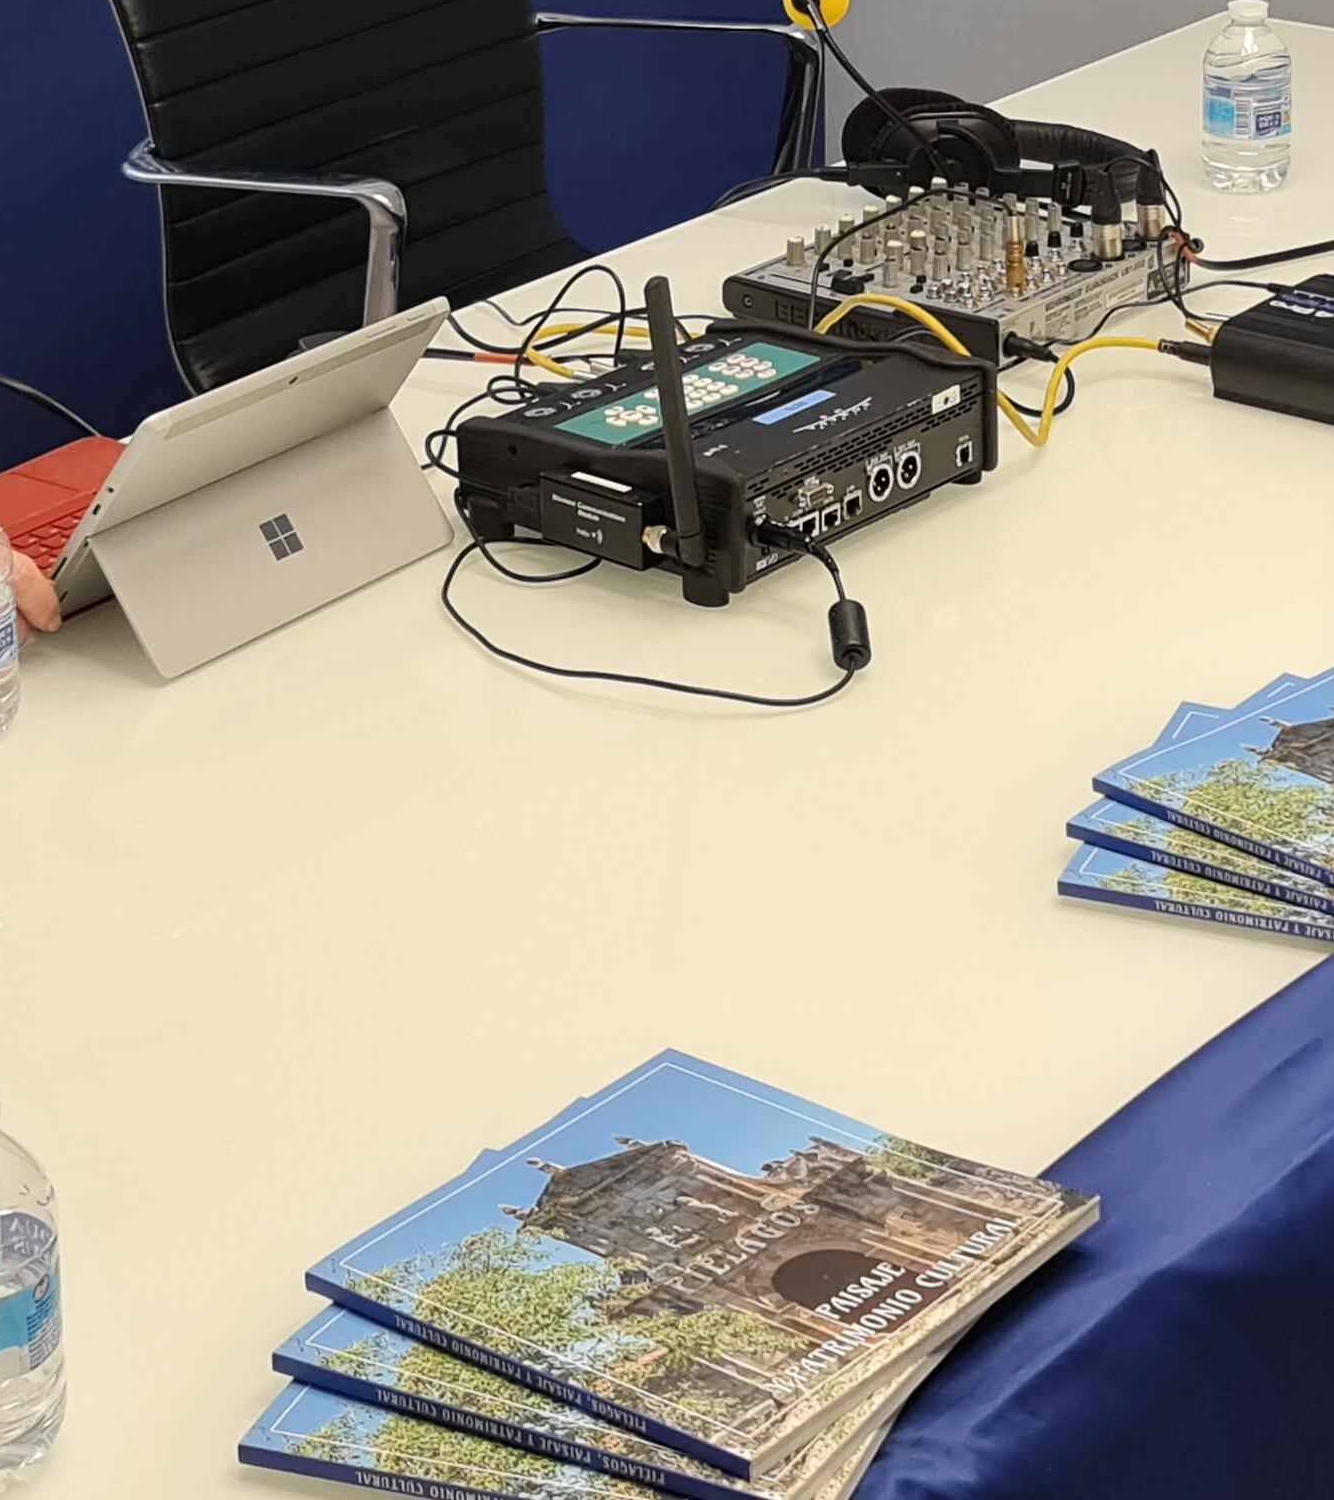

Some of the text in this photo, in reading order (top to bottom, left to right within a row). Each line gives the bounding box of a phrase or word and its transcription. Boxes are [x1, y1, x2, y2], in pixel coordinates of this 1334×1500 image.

[785, 1288, 923, 1386] PATRIMONIO
[914, 1217, 1019, 1288] CULTURAL
[814, 1261, 907, 1320] PAISAJE
[375, 1388, 438, 1420] CULTURAL
[441, 1406, 523, 1448] PATRIMONIO
[539, 1437, 592, 1465] PAISAJE
[354, 1470, 424, 1498] CULTURAL
